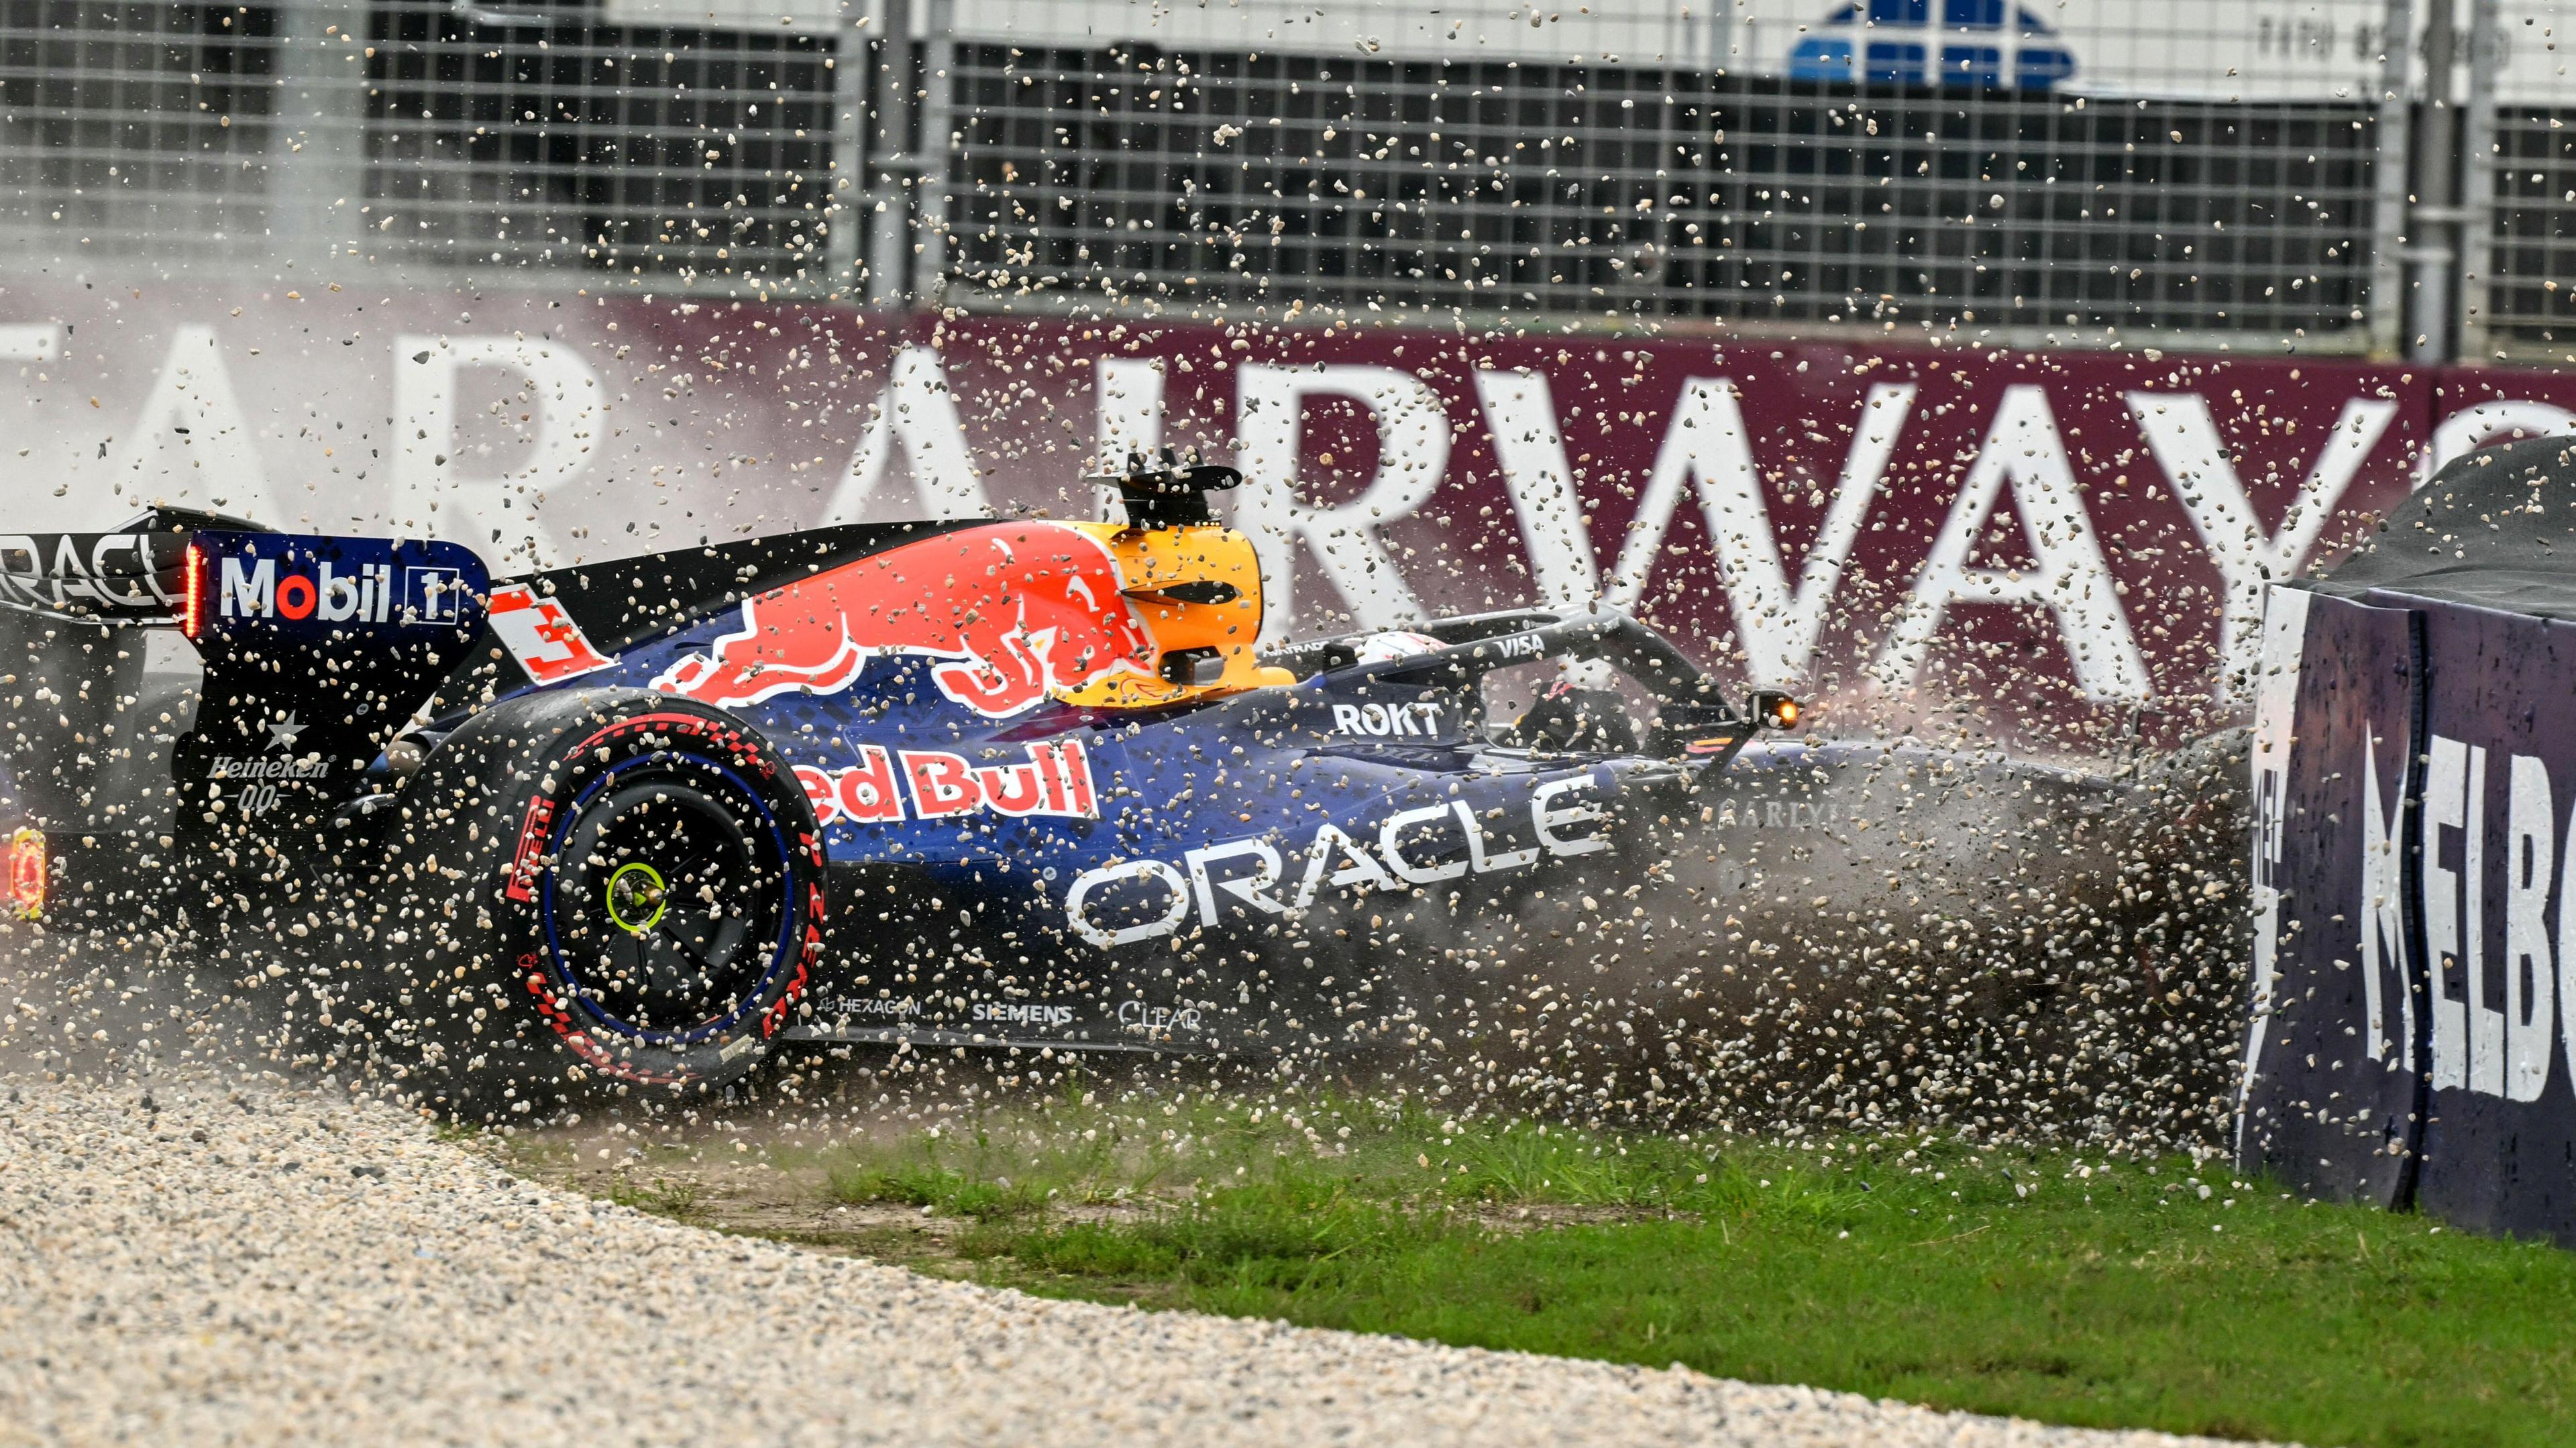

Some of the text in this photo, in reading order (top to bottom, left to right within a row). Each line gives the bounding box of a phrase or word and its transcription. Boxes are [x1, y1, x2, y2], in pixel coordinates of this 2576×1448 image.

[0, 325, 2576, 708] AR AIRWAY
[0, 534, 191, 606] RACL
[221, 557, 439, 623] Mobil 1
[490, 582, 619, 685] 3
[1493, 634, 1545, 659] VISA
[1332, 703, 1440, 736] ROKT
[206, 757, 329, 778] Heineken
[792, 739, 1099, 827] ed Bull
[1067, 775, 1609, 946] ORACLE
[2361, 718, 2576, 1103] MELB
[973, 1004, 1073, 1023] SIEMENS
[1118, 1000, 1201, 1031] CLEAR
